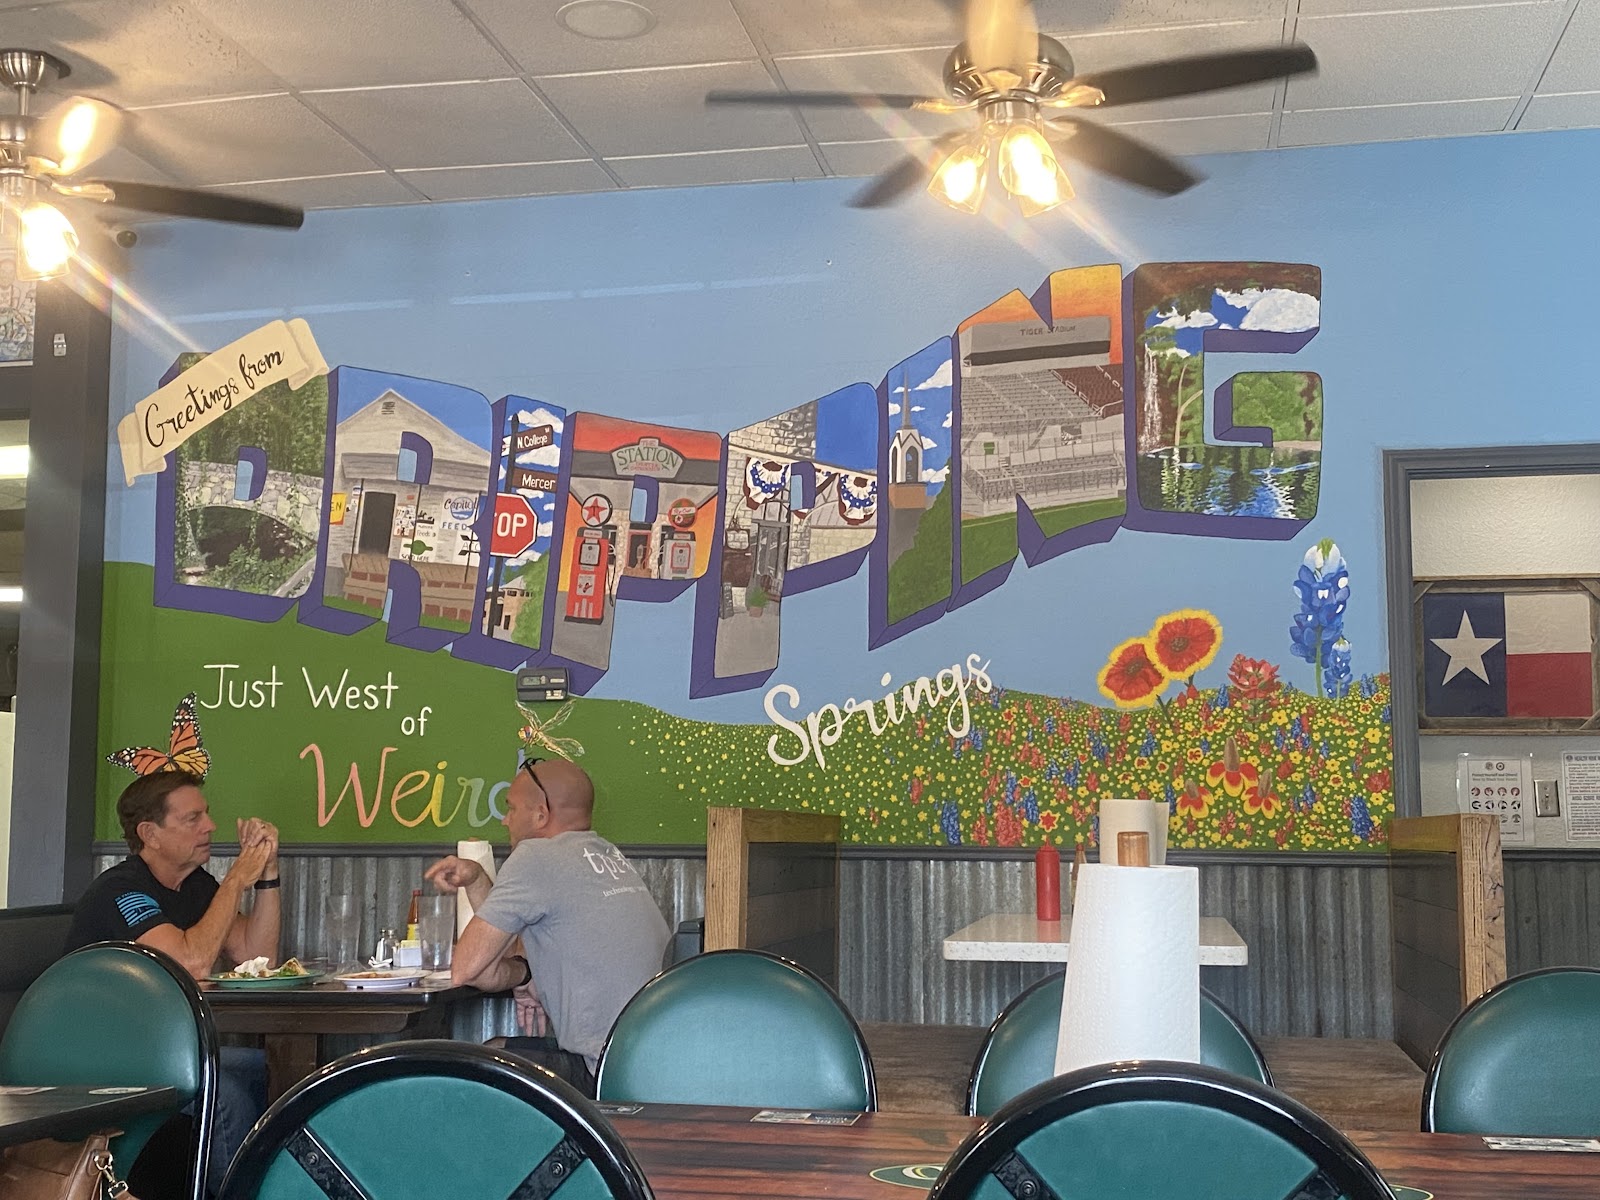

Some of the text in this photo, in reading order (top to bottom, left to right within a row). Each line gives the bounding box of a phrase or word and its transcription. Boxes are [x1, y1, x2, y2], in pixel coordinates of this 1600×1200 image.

[1020, 325, 1076, 336] TIGER STADIUM
[145, 349, 285, 448] Greetings from
[524, 434, 548, 448] College
[616, 446, 679, 469] STATION
[155, 261, 1323, 699] DRIPPING
[521, 473, 556, 490] Mercer
[200, 664, 399, 710] Just West
[400, 706, 432, 737] of
[763, 653, 992, 774] Springs
